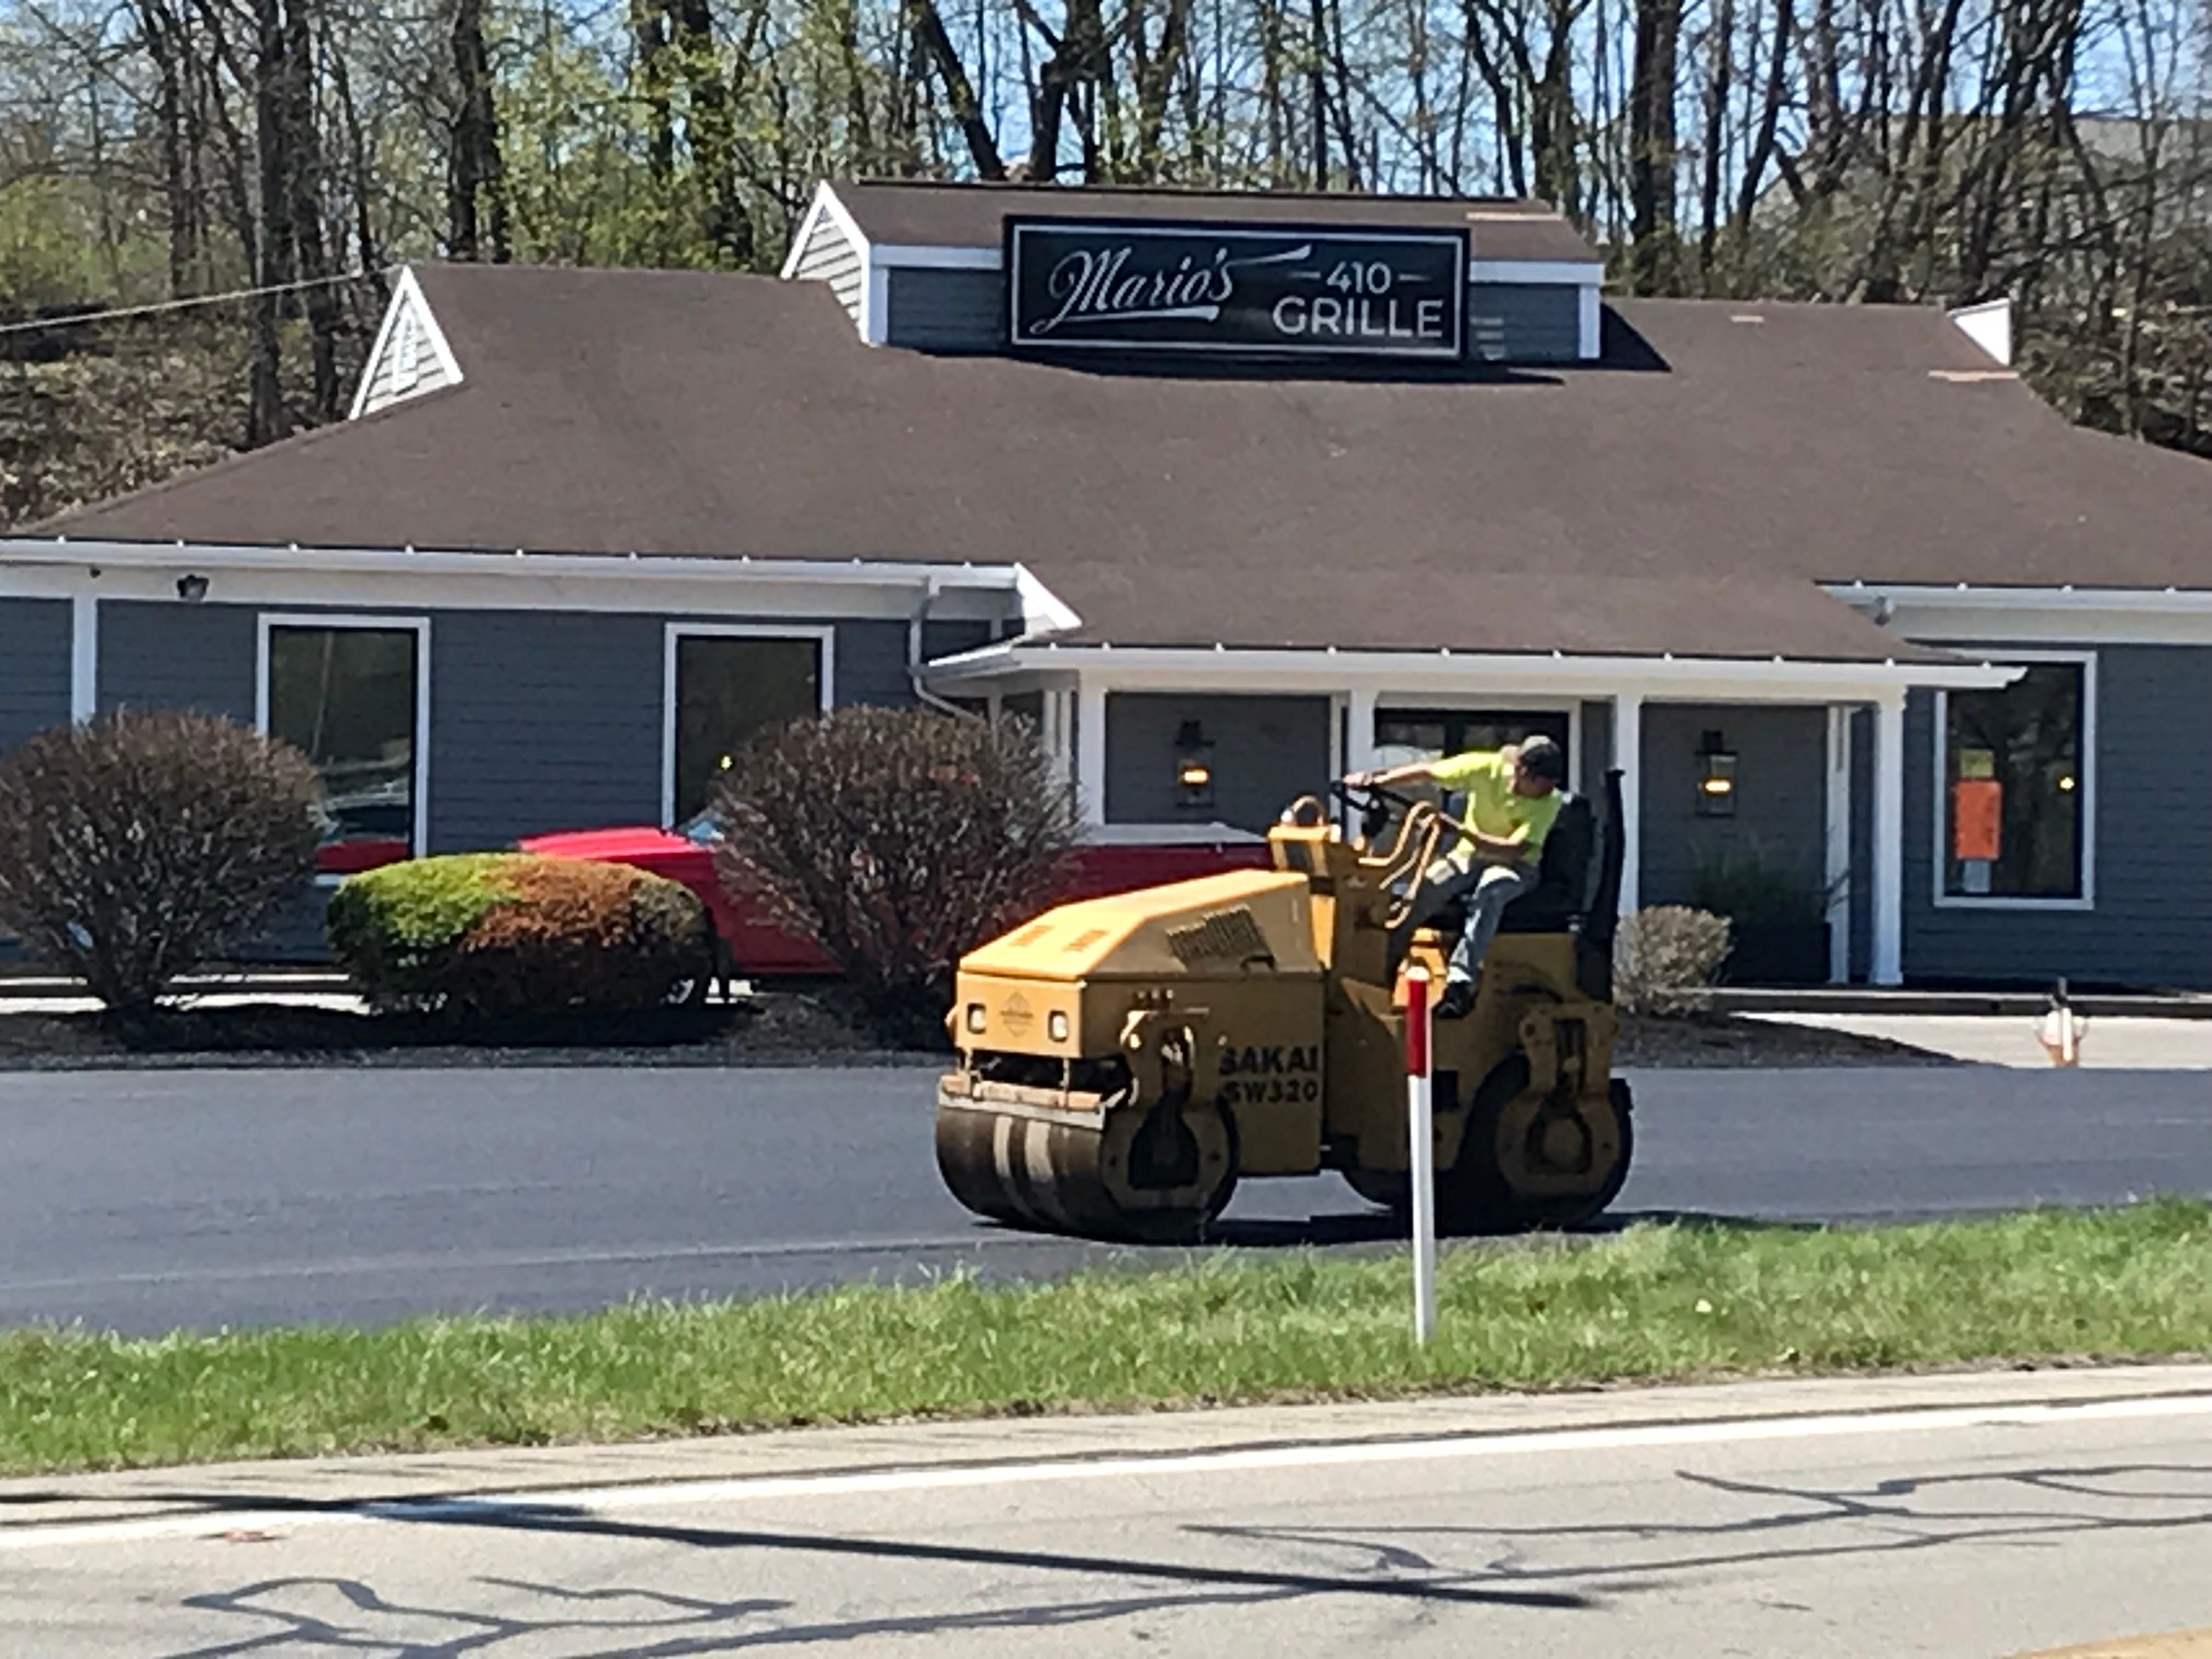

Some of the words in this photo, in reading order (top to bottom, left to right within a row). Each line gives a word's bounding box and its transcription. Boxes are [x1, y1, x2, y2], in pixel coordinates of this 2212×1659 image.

[1030, 245, 1311, 334] Mario's
[1273, 296, 1444, 338] GRILLE
[1218, 1045, 1318, 1075] SAKAI
[1224, 1079, 1318, 1103] SW320
